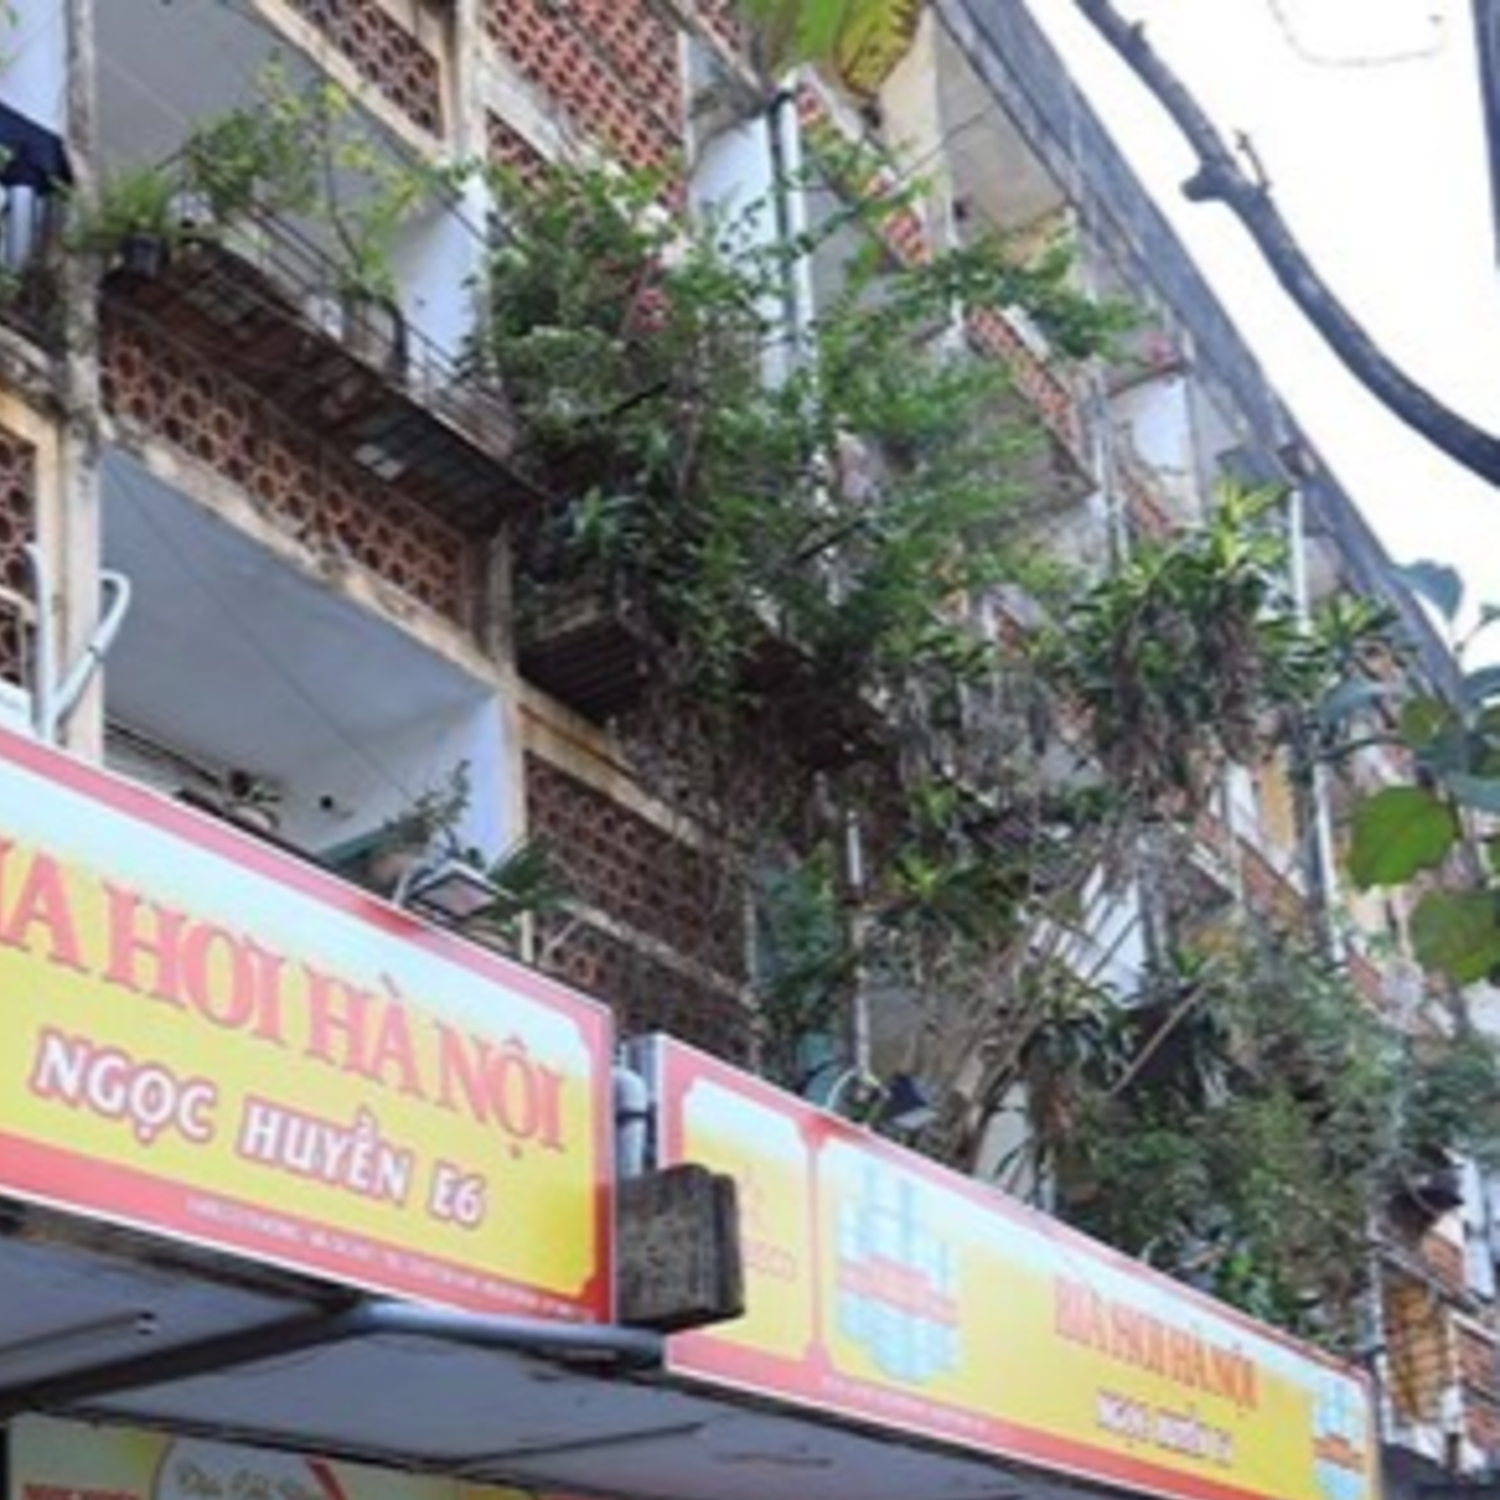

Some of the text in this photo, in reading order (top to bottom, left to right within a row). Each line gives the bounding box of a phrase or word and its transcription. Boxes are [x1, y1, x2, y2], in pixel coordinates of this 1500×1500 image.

[33, 1026, 216, 1145] NGỌC
[430, 1162, 484, 1227] E6
[299, 972, 429, 1103] HÀ
[434, 1019, 566, 1159] NỘI
